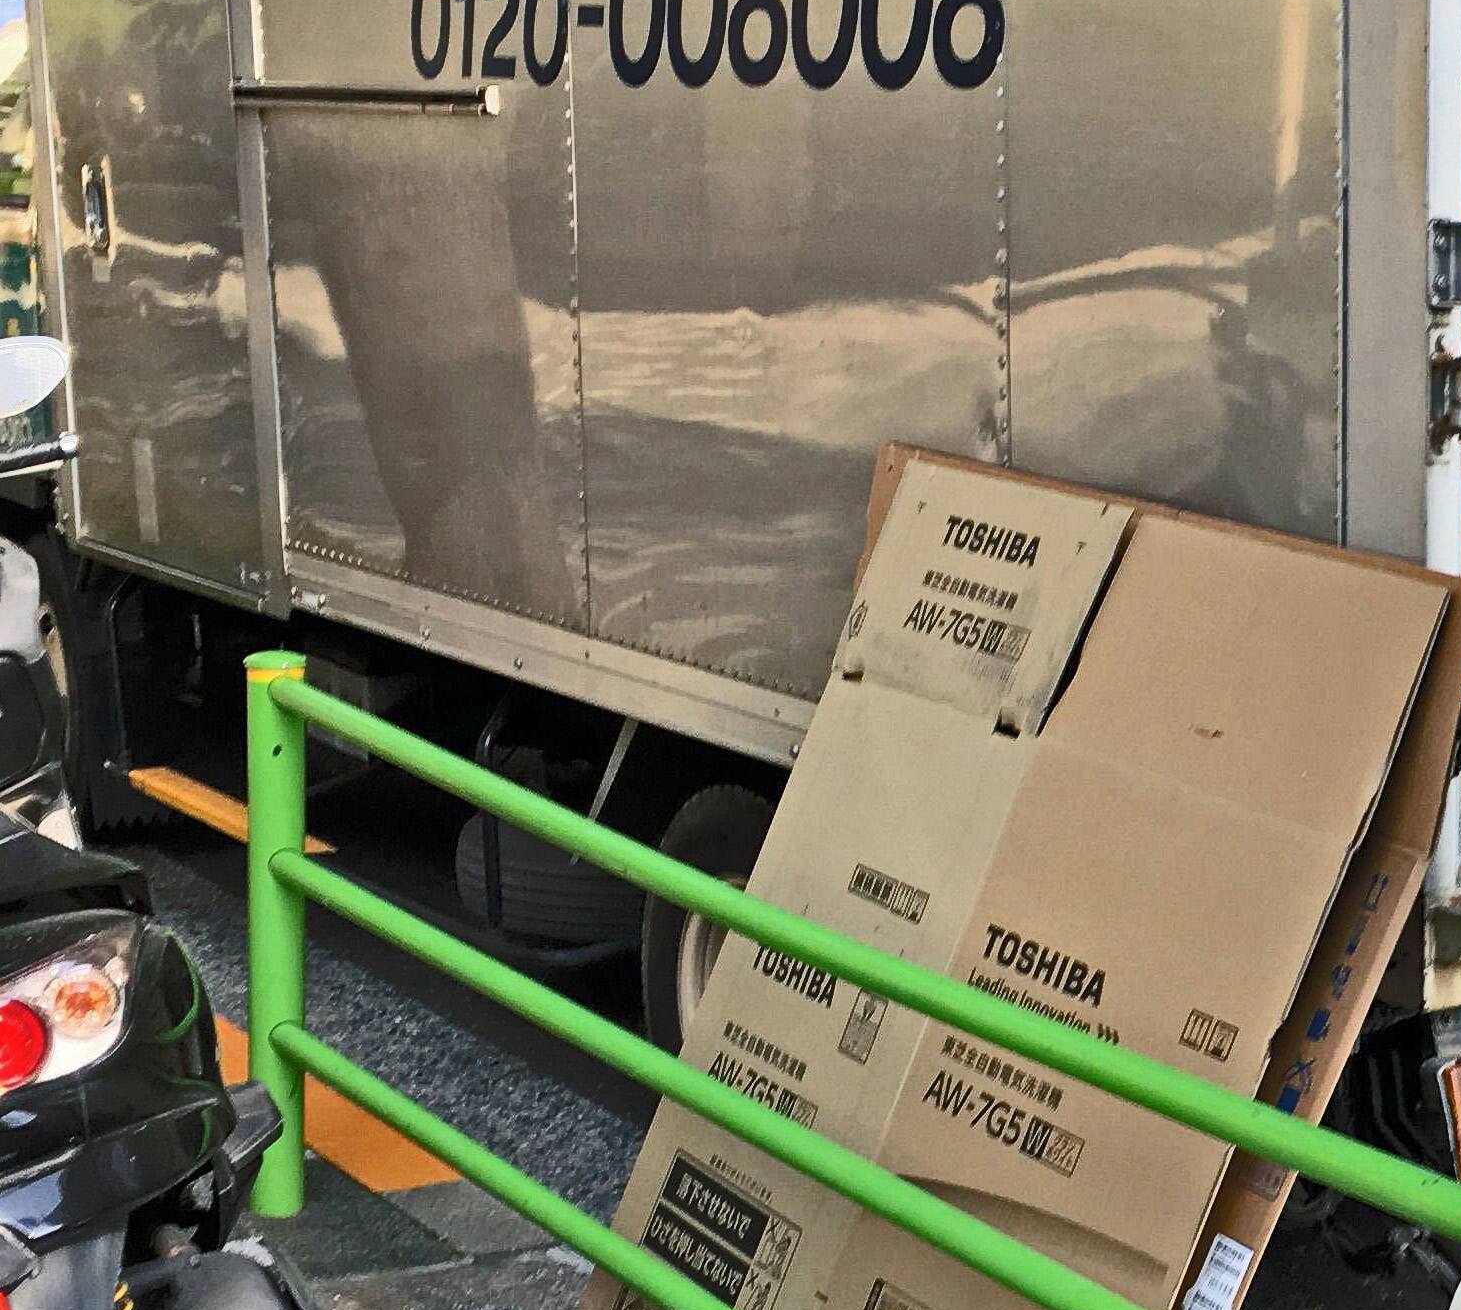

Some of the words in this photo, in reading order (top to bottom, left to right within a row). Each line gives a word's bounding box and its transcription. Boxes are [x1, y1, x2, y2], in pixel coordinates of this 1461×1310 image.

[942, 514, 1041, 567] TOSHIBA
[753, 946, 838, 1010] TOSHIBA
[982, 922, 1106, 1008] TOSHIBA
